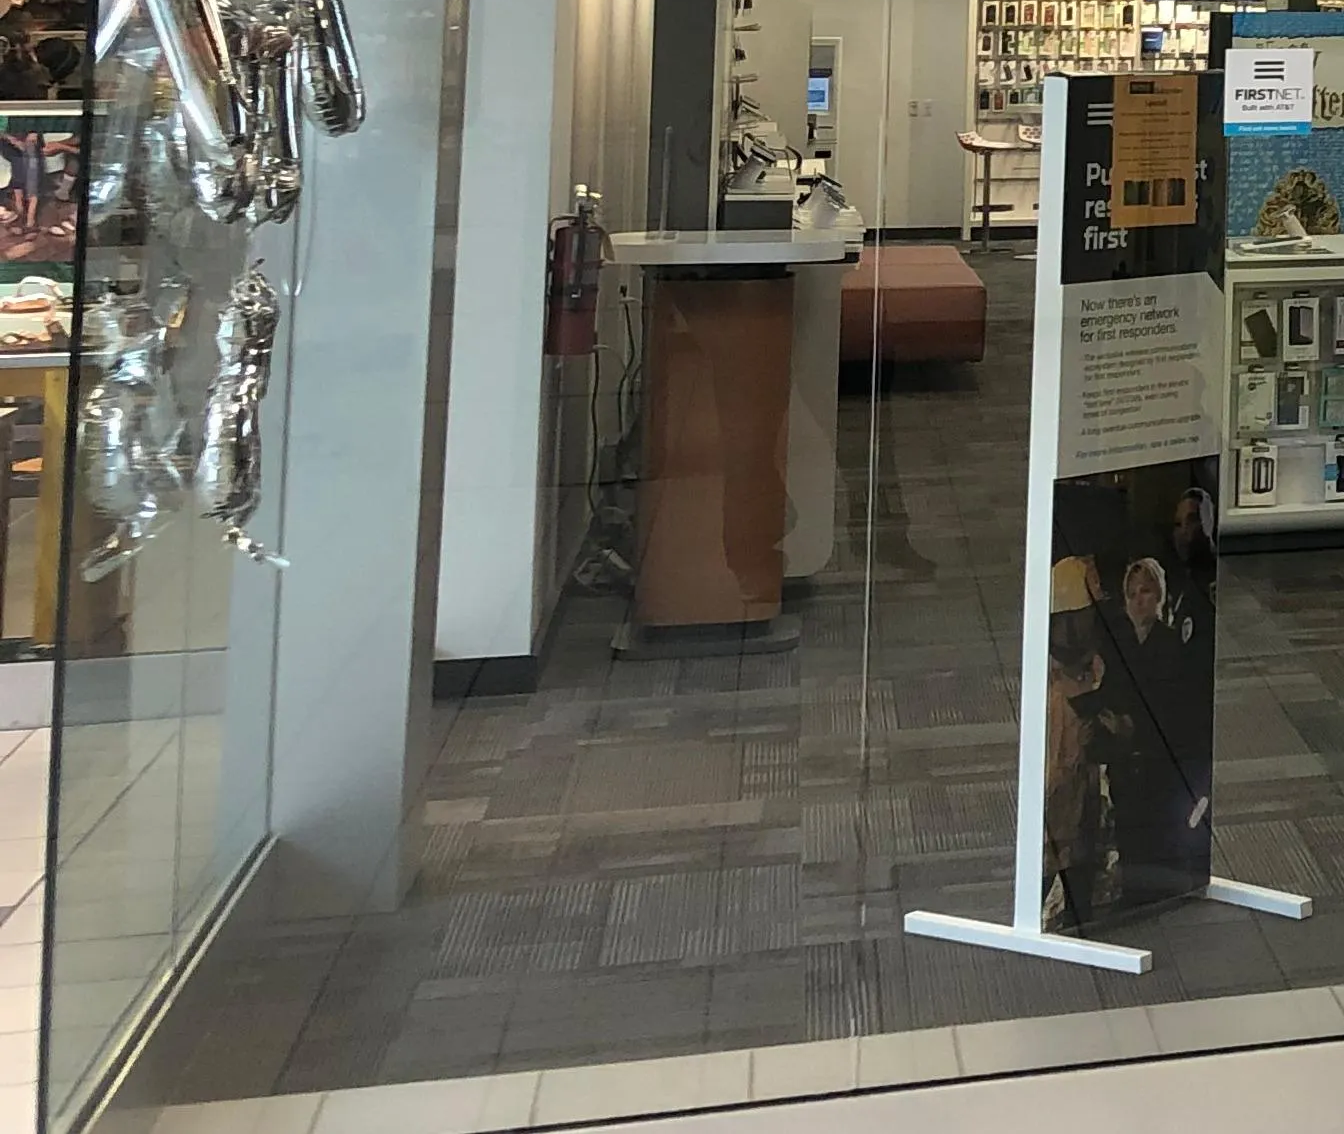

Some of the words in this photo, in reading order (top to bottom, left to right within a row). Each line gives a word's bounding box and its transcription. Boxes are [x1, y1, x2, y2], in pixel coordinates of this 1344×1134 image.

[1083, 225, 1129, 251] first
[1081, 298, 1105, 313] Now
[1108, 294, 1142, 309] there's
[1143, 294, 1158, 306] an
[1080, 312, 1138, 328] emergency
[1139, 307, 1180, 321] network
[1080, 330, 1095, 344] for
[1096, 328, 1116, 341] first
